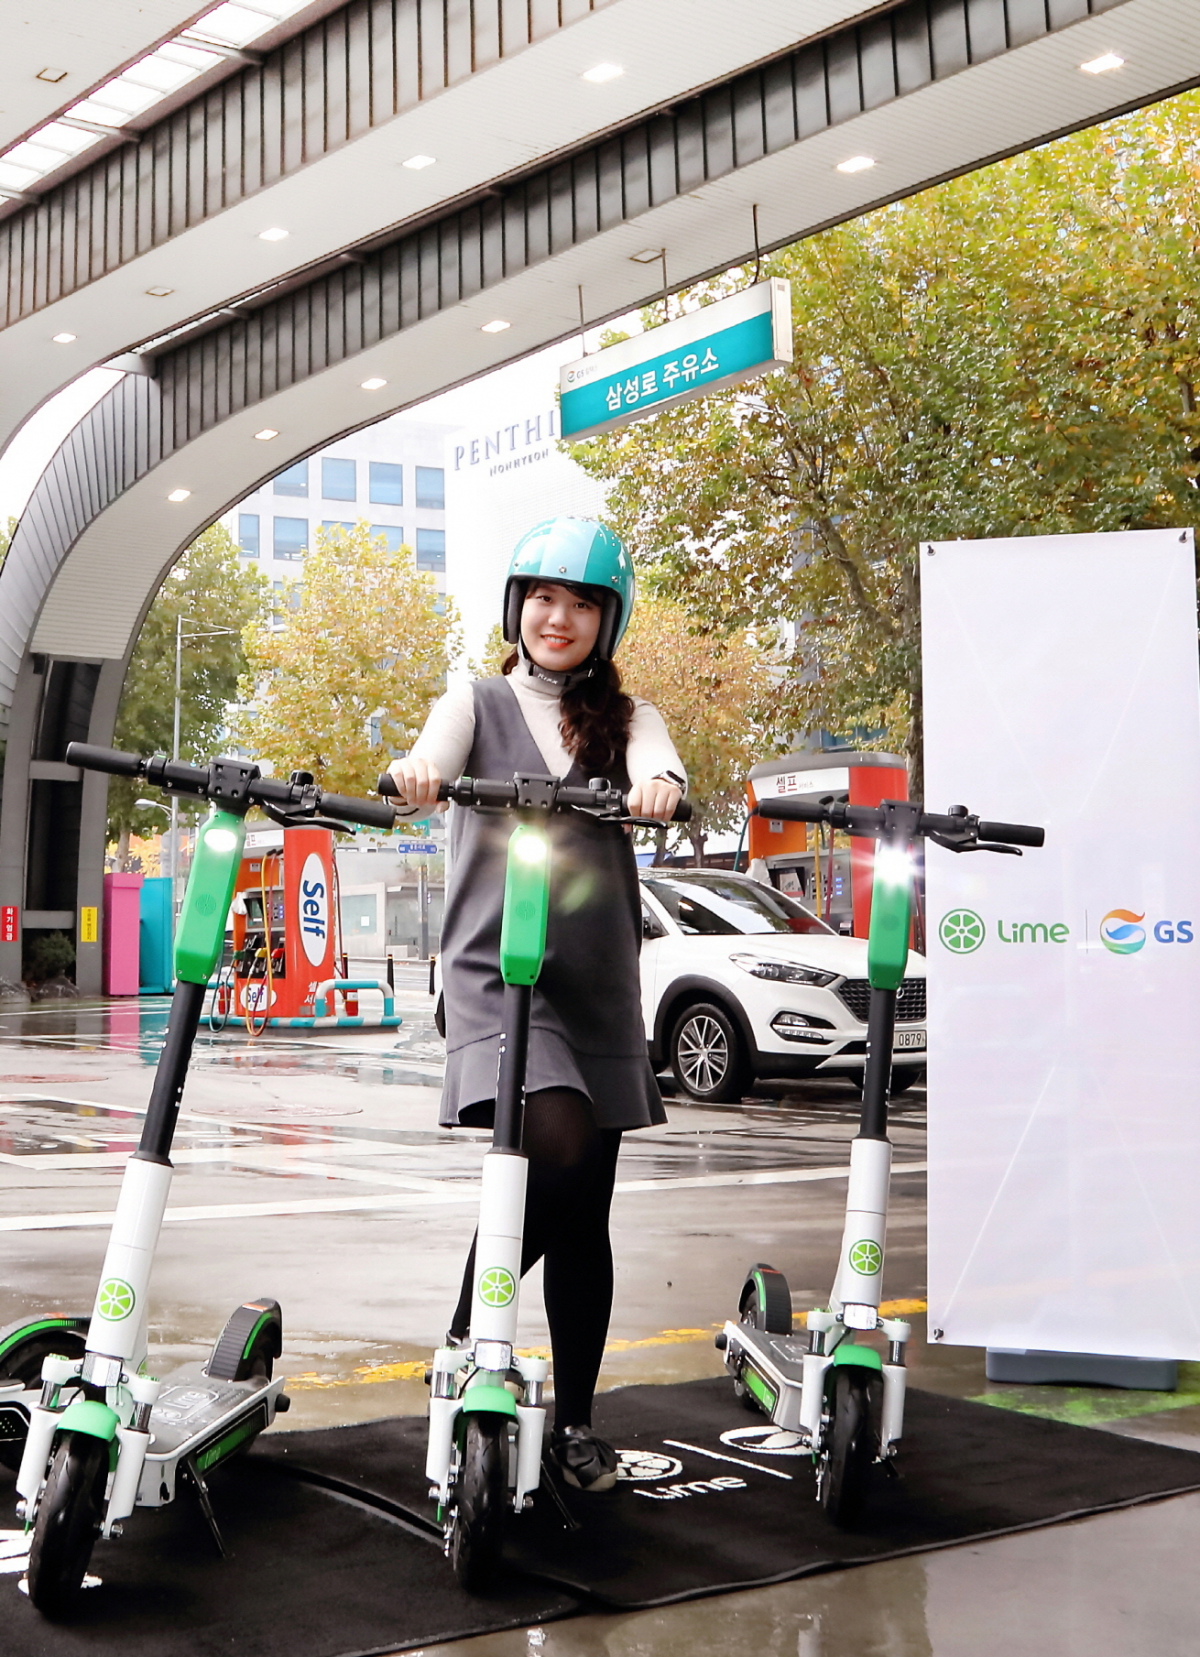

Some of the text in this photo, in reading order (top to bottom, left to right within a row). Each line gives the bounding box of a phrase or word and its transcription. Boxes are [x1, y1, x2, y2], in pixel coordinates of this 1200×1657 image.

[605, 347, 719, 411] 삼성로 주유소
[454, 410, 556, 471] PENTHI
[776, 774, 798, 794] 셀프
[302, 880, 326, 940] Self
[1153, 920, 1194, 944] GS
[898, 1033, 922, 1047] 0879
